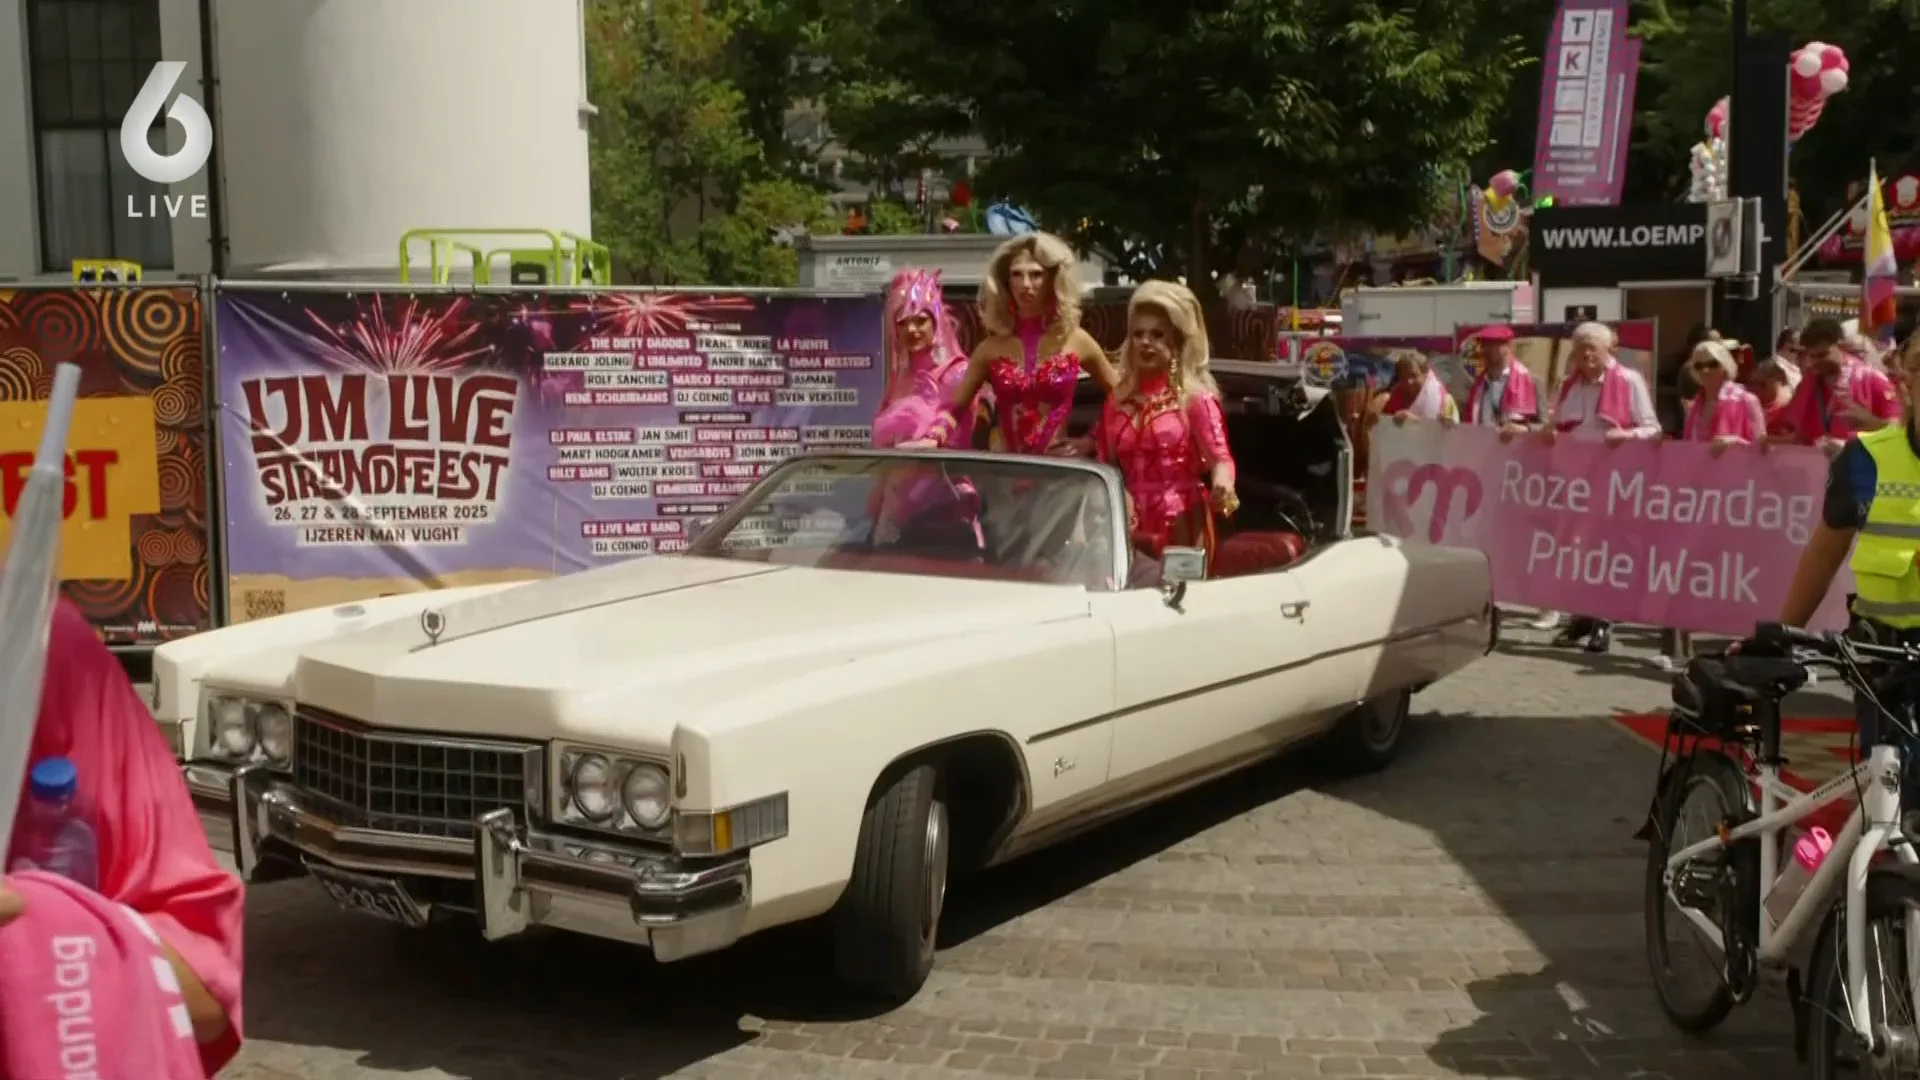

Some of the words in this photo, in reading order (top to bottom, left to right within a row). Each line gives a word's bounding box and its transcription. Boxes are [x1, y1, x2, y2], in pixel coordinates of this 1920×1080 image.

[1565, 51, 1581, 71] K
[547, 355, 590, 367] GERARD
[594, 355, 630, 367] JOLING
[587, 374, 613, 385] ROLF
[616, 374, 664, 385] SANCHEZ
[677, 393, 688, 402] DJ
[778, 392, 805, 402] SVEN
[387, 374, 518, 448] LIVE
[640, 430, 660, 441] JAN
[664, 430, 689, 441] SMIT
[560, 449, 592, 459] MART
[740, 448, 766, 457] JOHN
[770, 447, 798, 457] WEST
[618, 466, 657, 477] WOLTER
[594, 484, 607, 495] DJ
[1500, 460, 1591, 512] Roze
[1607, 469, 1814, 547] Maandag
[301, 506, 317, 520] 27
[324, 506, 334, 519] &
[342, 506, 359, 519] 28
[365, 506, 447, 520] SEPTEMBER
[453, 505, 488, 519] 2025
[305, 527, 365, 543] IJZEREN
[369, 527, 405, 542] MAN
[411, 526, 460, 541] VUGHT
[595, 541, 608, 552] DJ
[1527, 531, 1634, 589] Pride
[1648, 545, 1761, 604] Walk
[46, 934, 97, 1080] andag
